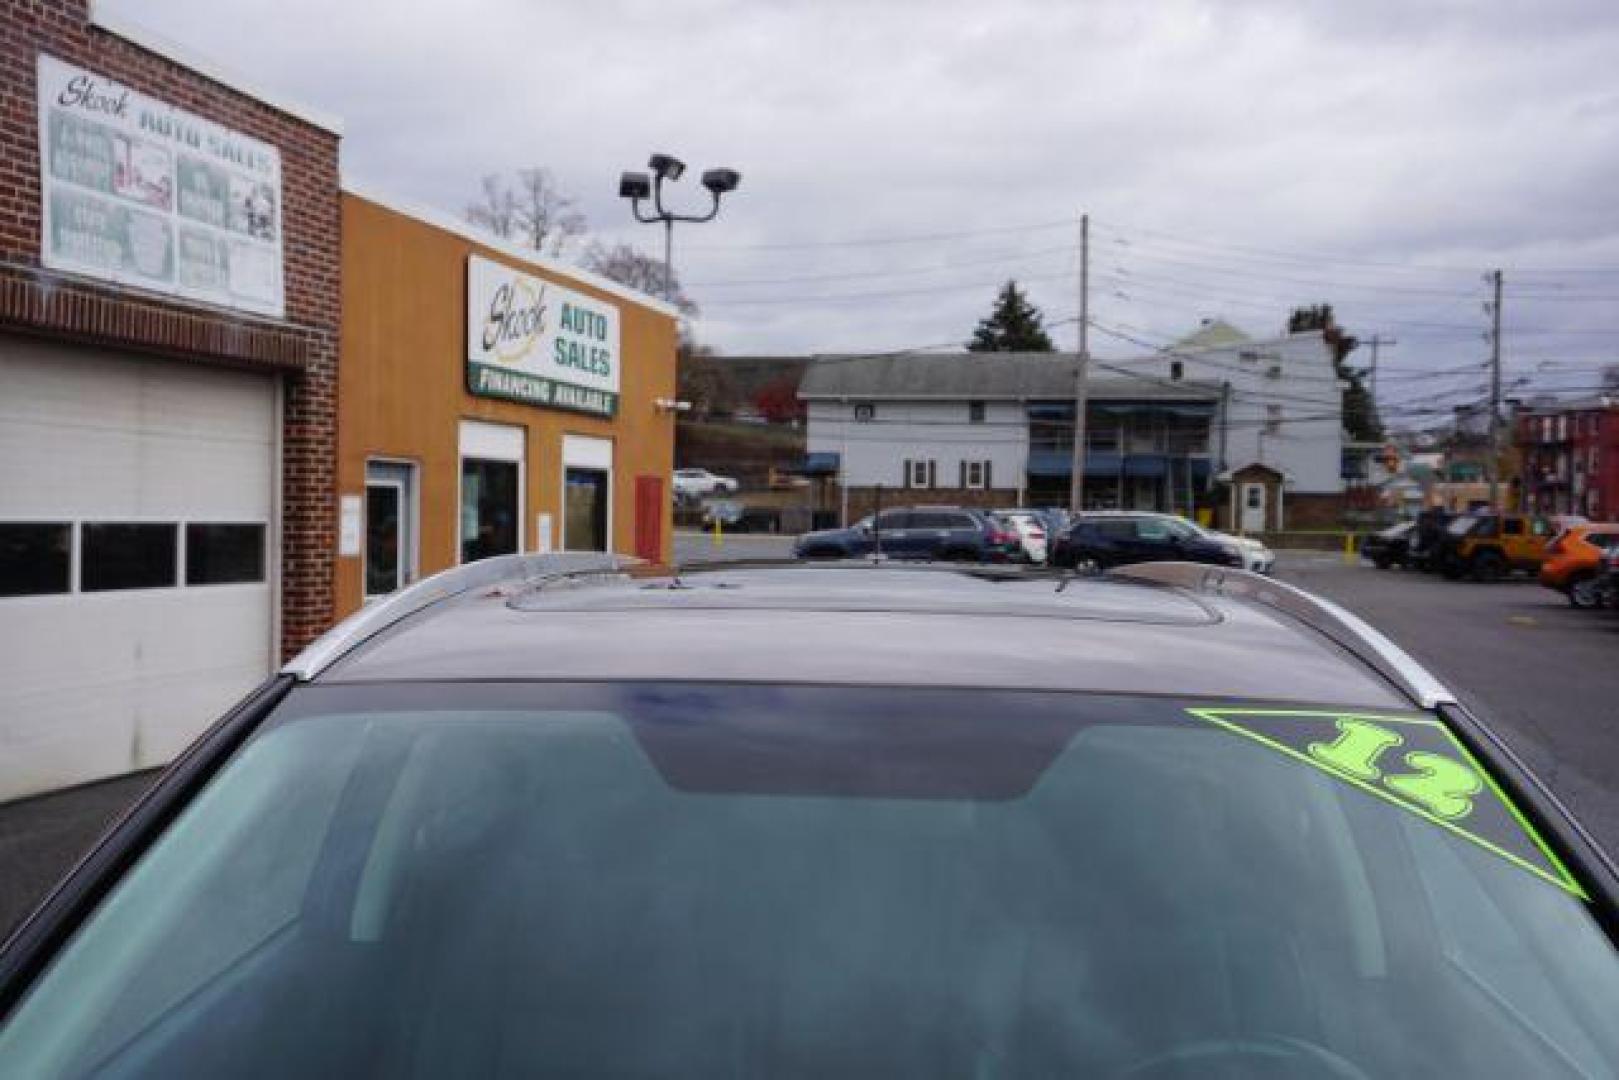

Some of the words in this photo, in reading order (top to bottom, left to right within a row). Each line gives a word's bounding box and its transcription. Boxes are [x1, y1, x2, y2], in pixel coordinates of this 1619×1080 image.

[57, 75, 129, 119] Skook
[138, 110, 202, 147] AUTO
[482, 280, 547, 352] Skook
[560, 302, 608, 341] AUTO
[554, 336, 611, 377] SALES
[1307, 717, 1484, 820] 12
